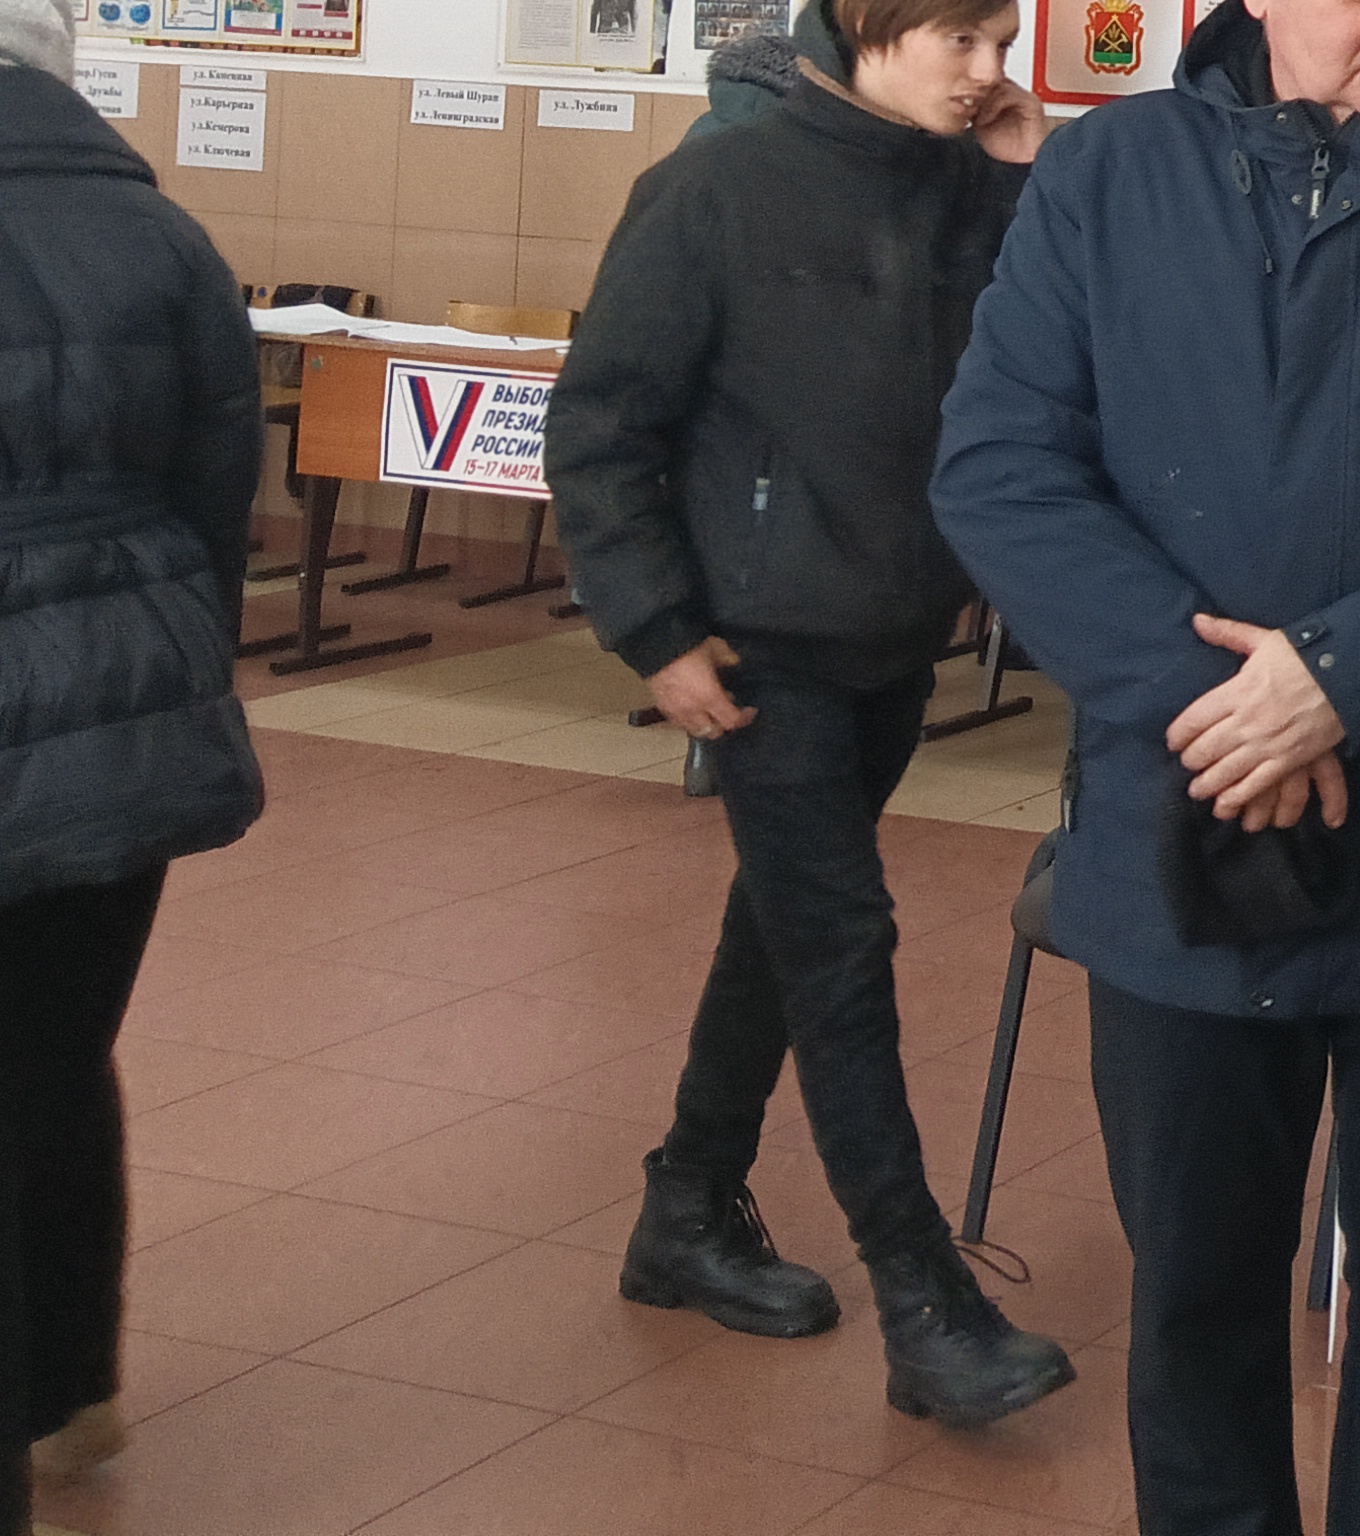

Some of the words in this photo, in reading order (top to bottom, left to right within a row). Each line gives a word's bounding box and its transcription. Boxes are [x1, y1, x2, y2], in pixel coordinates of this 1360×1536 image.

[203, 144, 251, 158] Ключевая
[481, 409, 547, 434] ПРЕЗИД
[471, 434, 543, 459] РОССИИ
[500, 461, 541, 482] МАРТА
